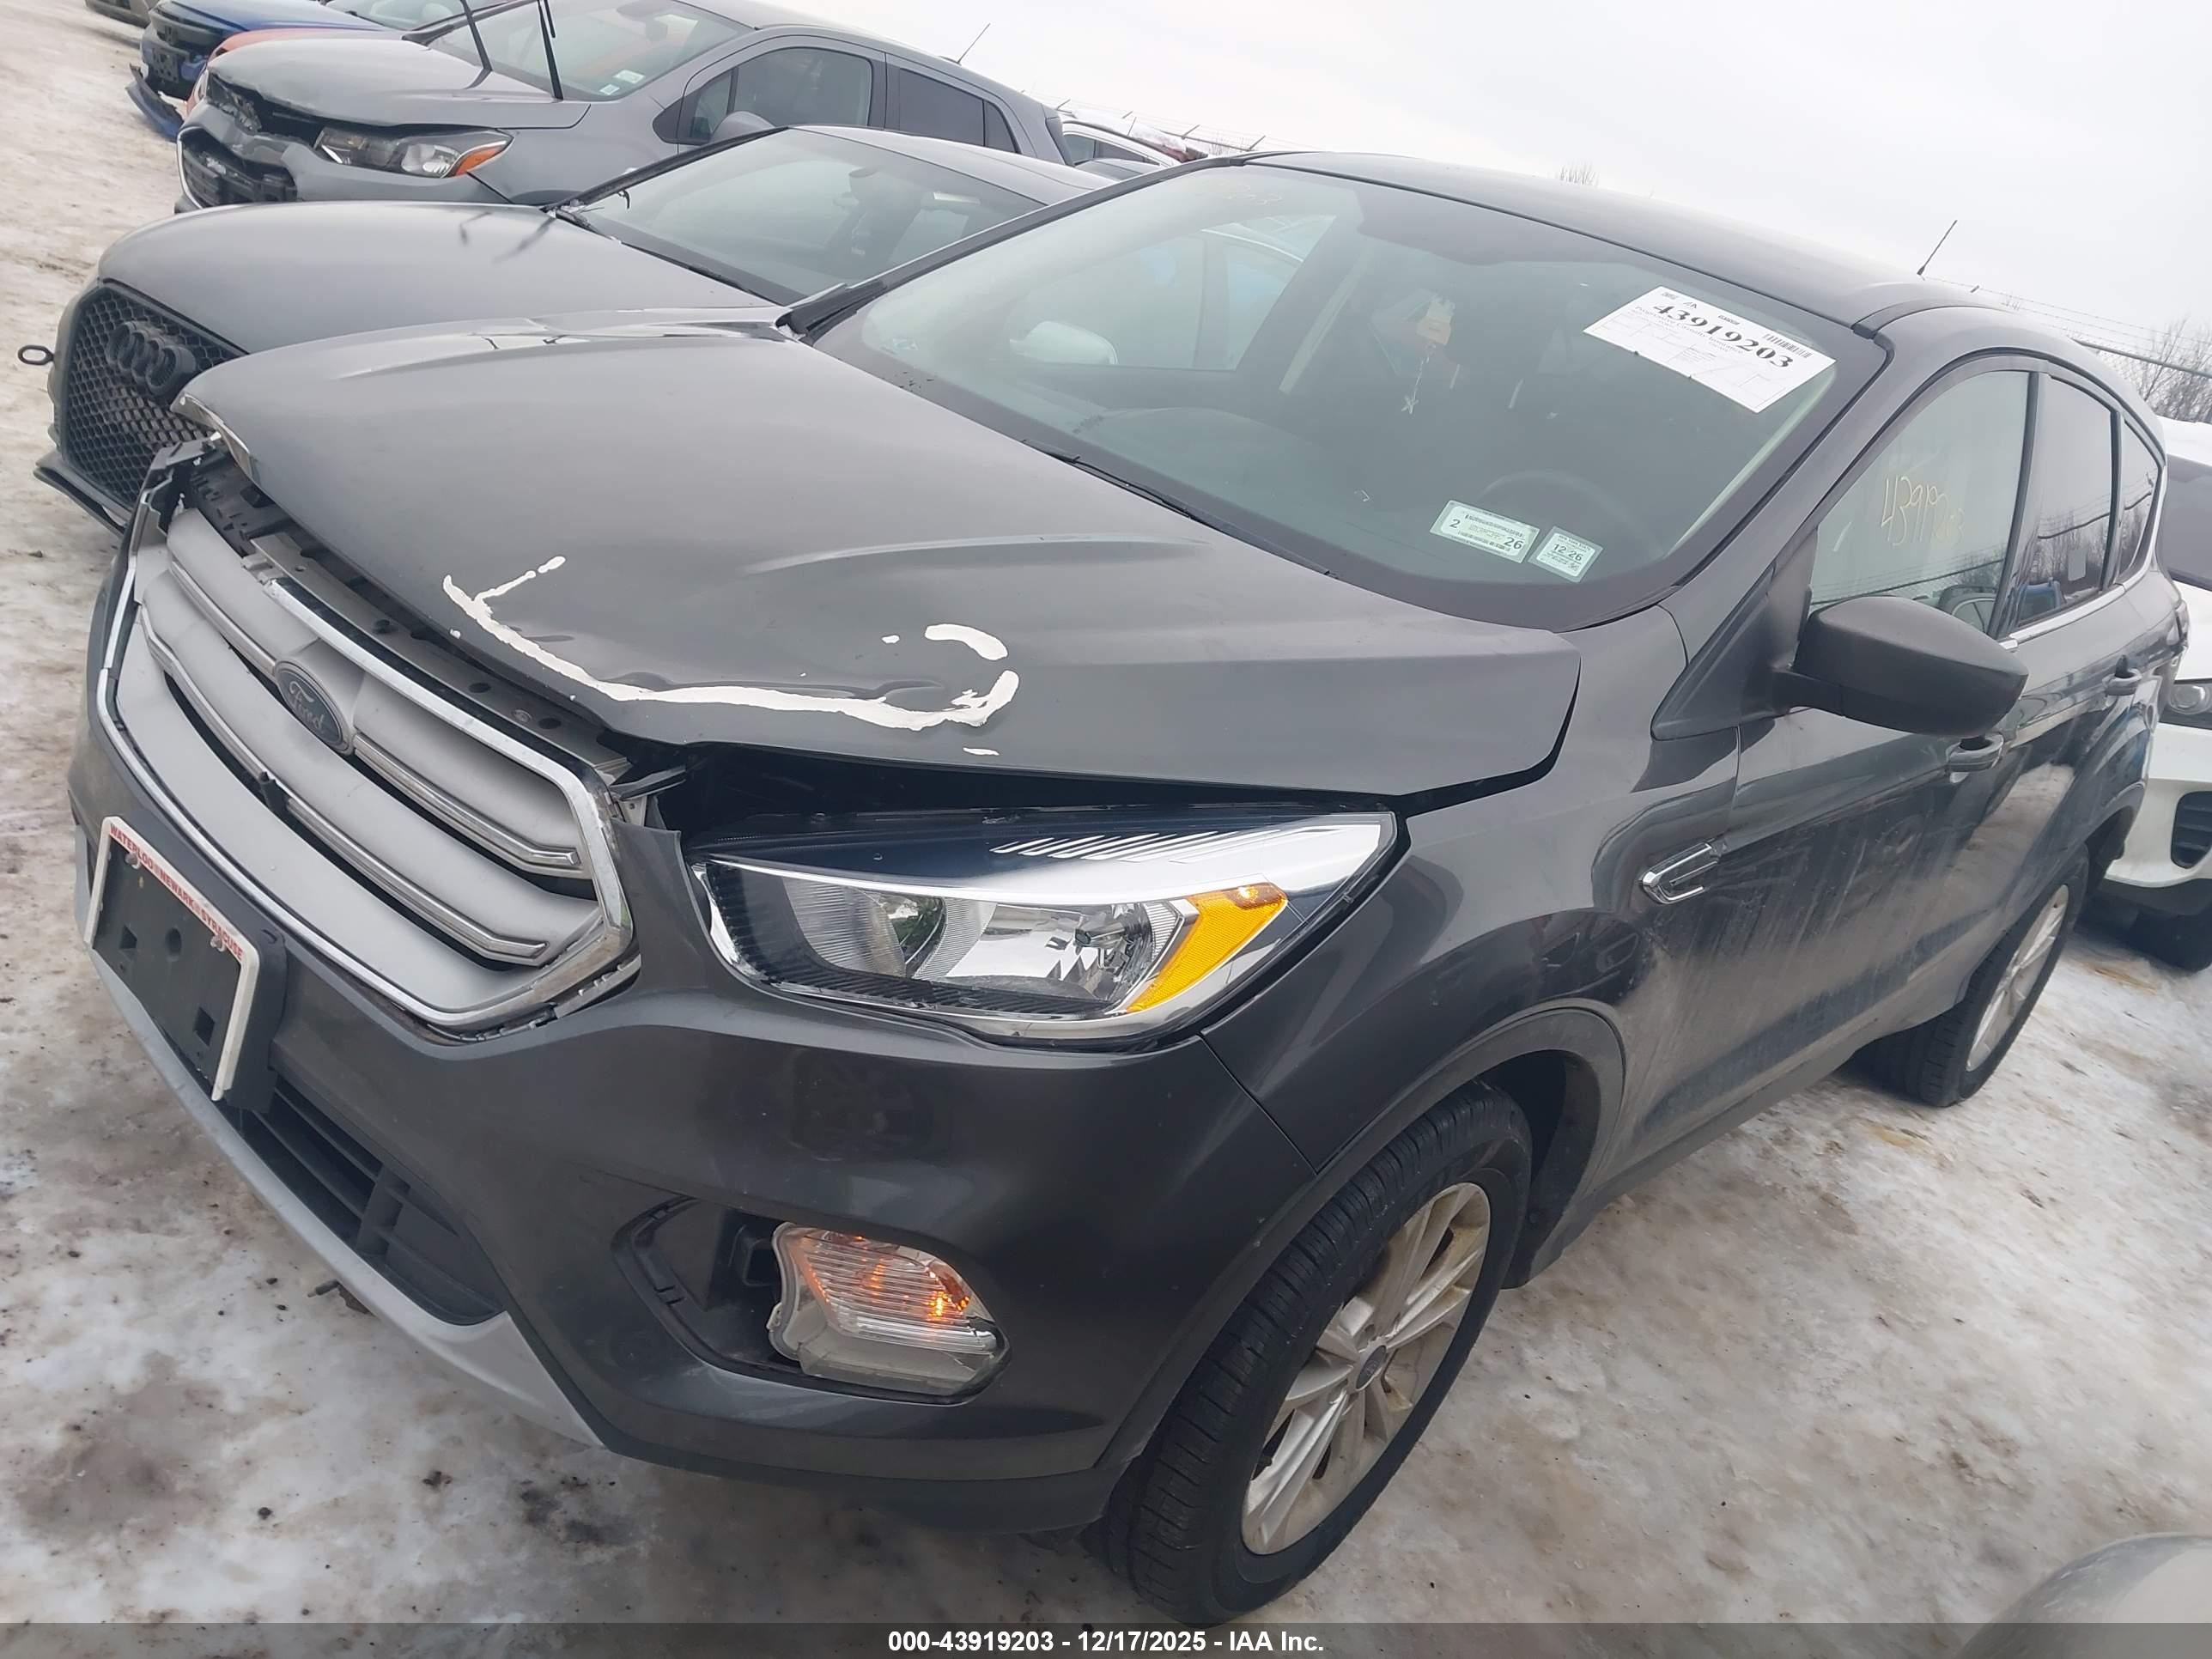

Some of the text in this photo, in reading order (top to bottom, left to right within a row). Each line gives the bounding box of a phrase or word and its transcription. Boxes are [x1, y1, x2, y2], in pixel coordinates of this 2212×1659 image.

[1653, 304, 1794, 368] 43919203
[1449, 518, 1462, 529] 2
[1503, 536, 1524, 550] 26
[1553, 543, 1568, 555] 12
[1567, 548, 1584, 562] 26
[288, 680, 325, 731] Ford
[110, 823, 243, 961] WATERLOO NEWARK SYRACUSE
